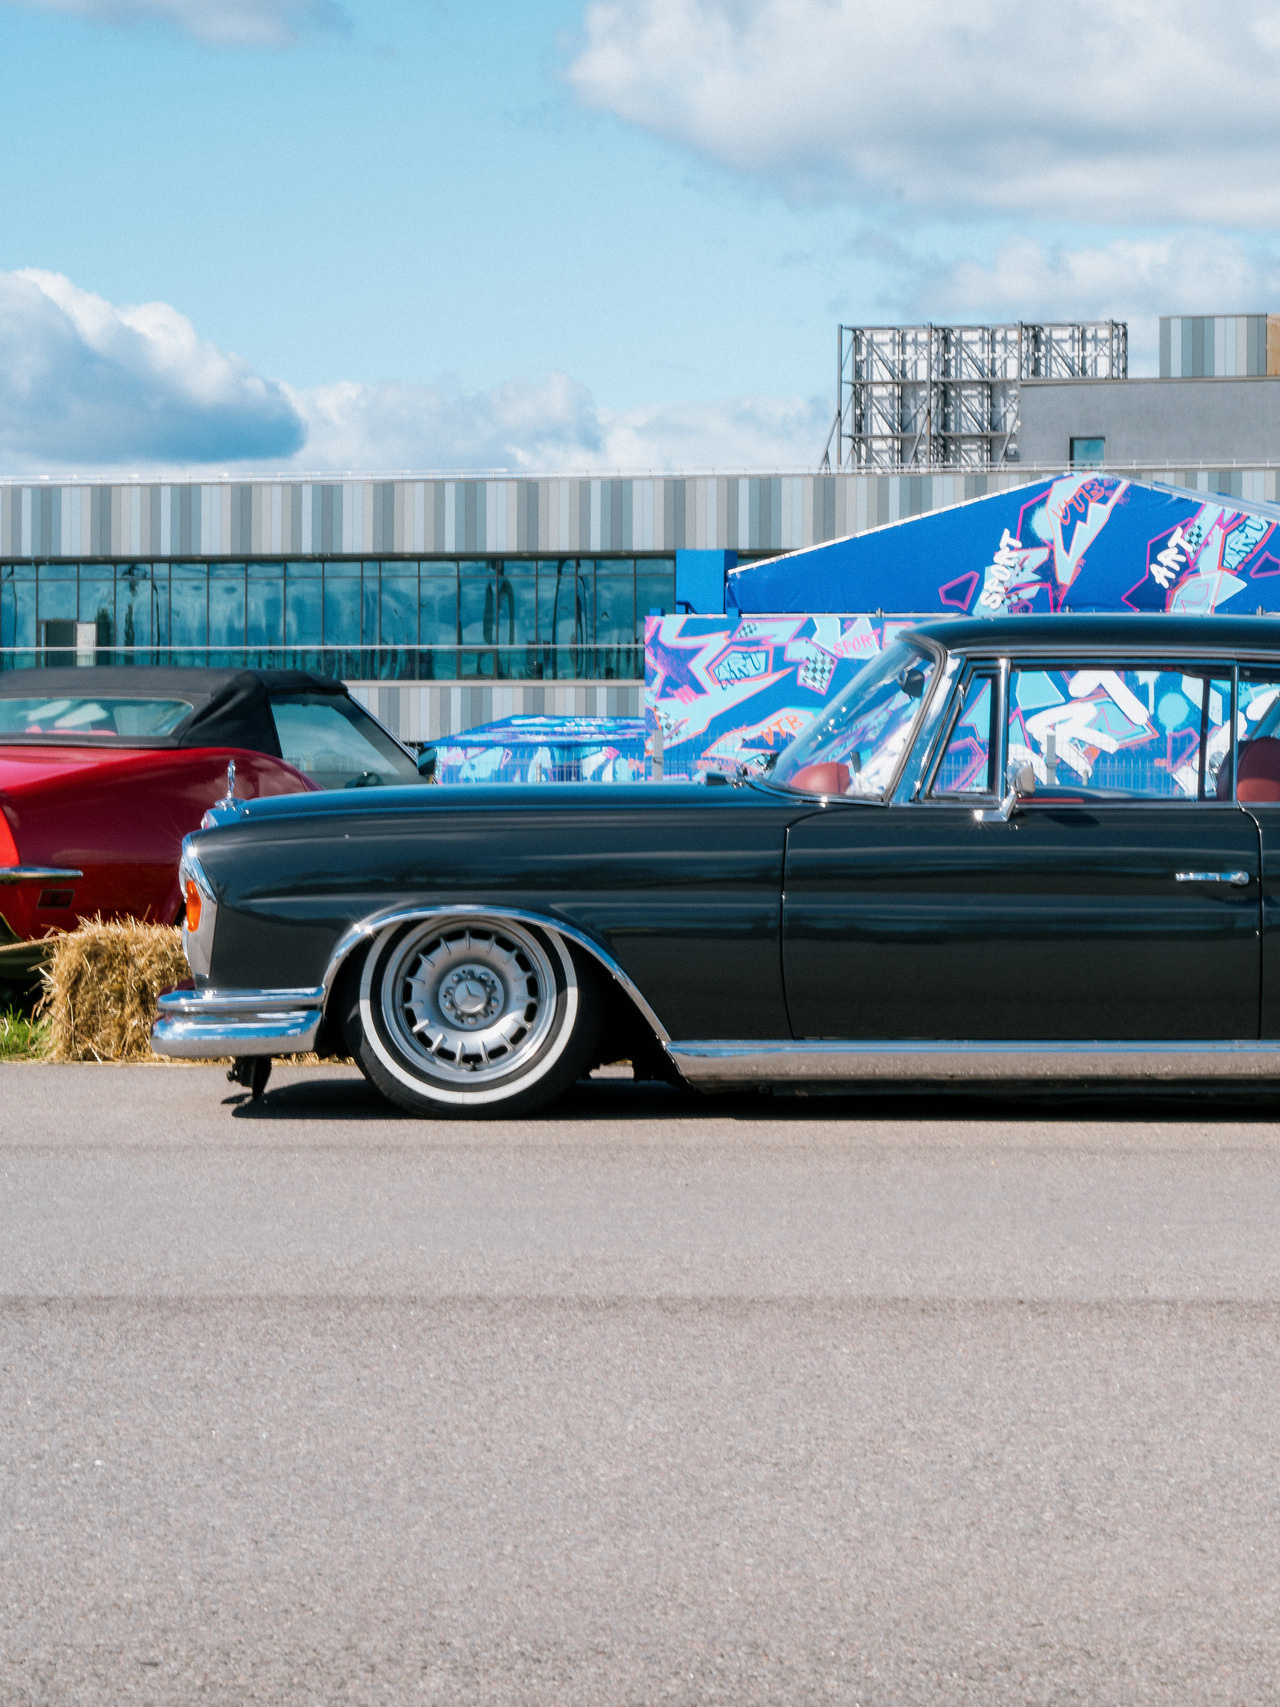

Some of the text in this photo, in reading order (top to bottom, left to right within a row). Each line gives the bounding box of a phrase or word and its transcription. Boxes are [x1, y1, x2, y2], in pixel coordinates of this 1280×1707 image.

[979, 527, 1023, 611] SPORT
[1150, 526, 1193, 589] ART
[833, 627, 881, 659] SPORT
[760, 714, 804, 746] VTB
